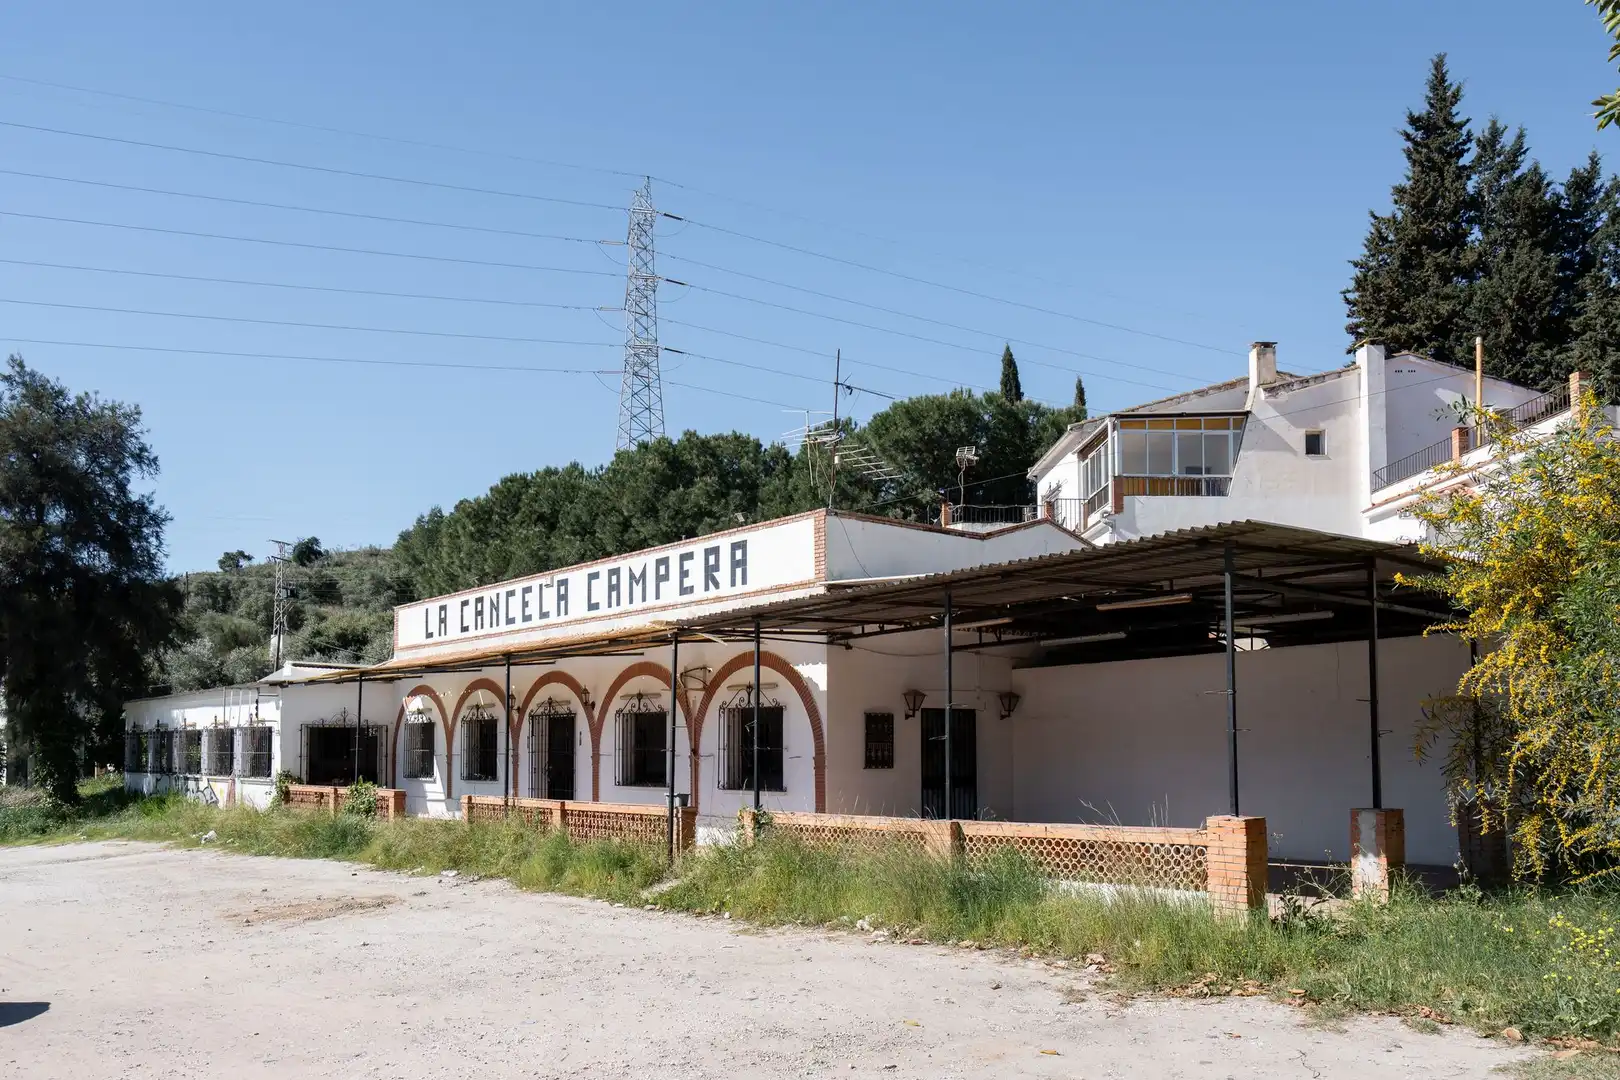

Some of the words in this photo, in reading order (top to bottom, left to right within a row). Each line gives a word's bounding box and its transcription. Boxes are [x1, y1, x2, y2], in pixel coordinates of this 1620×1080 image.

[425, 604, 448, 639] LA
[460, 578, 569, 633] CANCELA
[587, 539, 748, 612] CAMPERA
